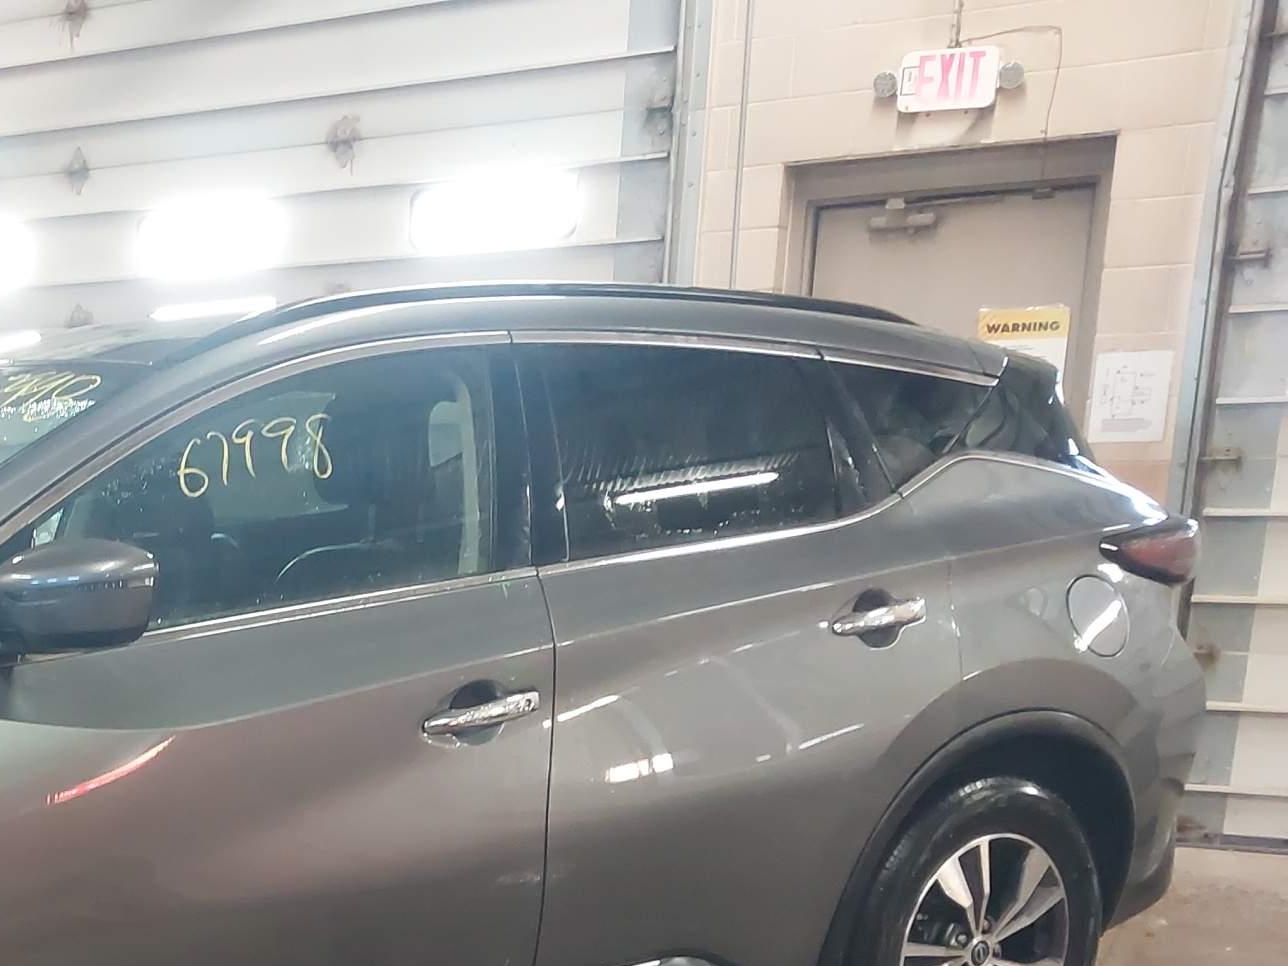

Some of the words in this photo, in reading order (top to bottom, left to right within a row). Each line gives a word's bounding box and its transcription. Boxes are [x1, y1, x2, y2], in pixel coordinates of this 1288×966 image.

[915, 50, 986, 100] EXIT
[985, 320, 1061, 334] WARNING
[177, 412, 334, 498] 67998
